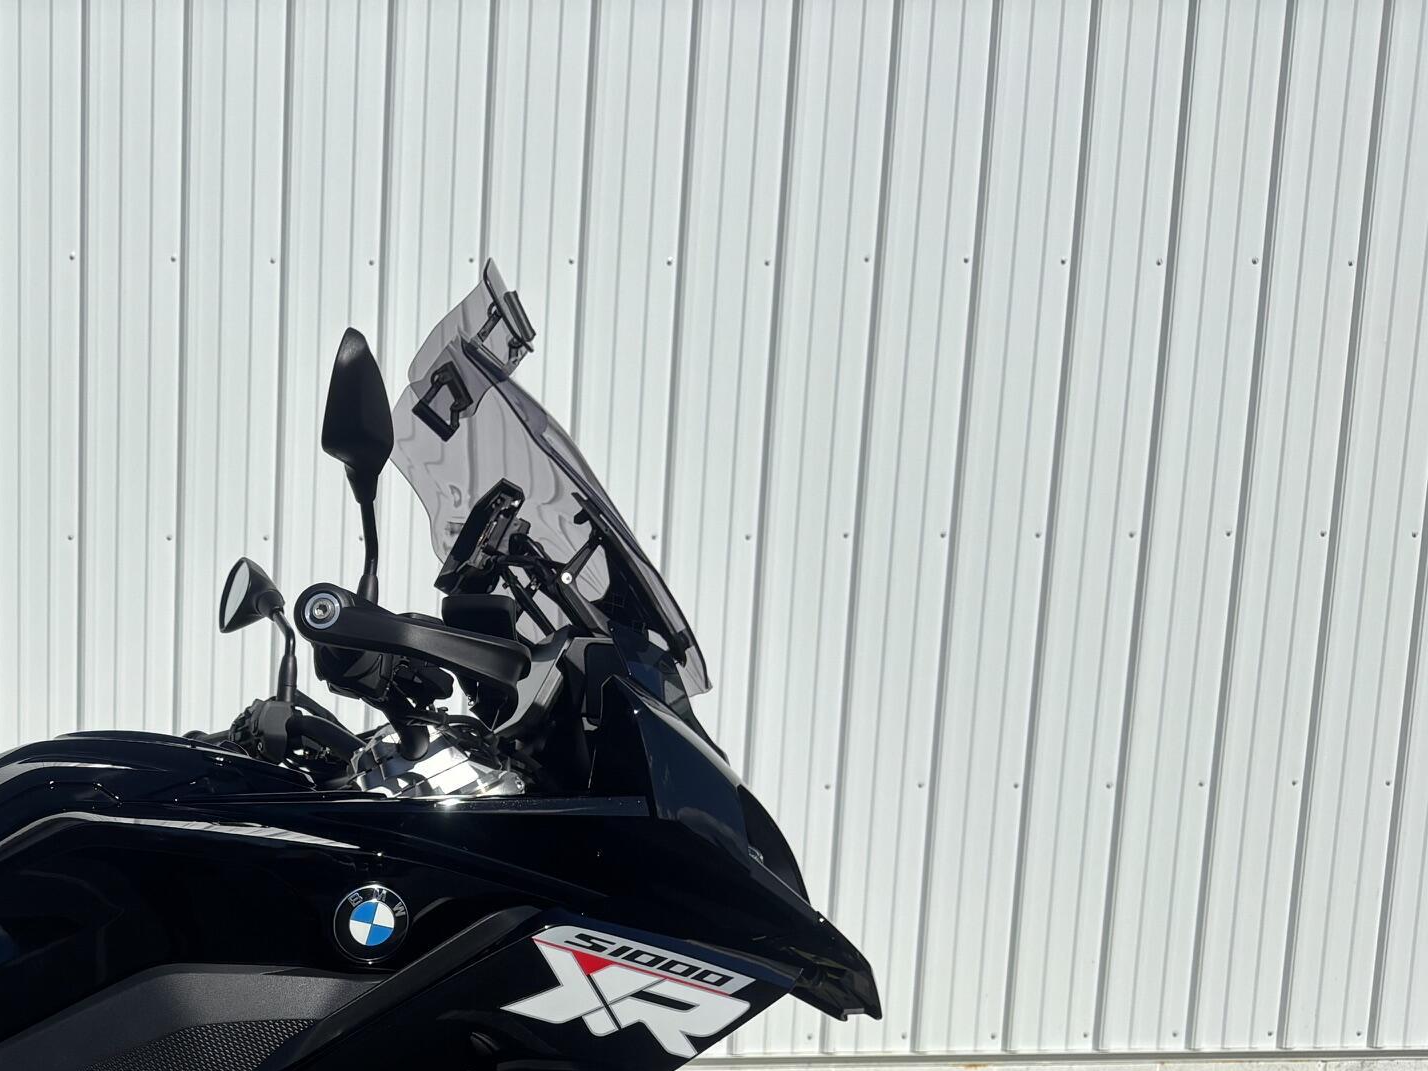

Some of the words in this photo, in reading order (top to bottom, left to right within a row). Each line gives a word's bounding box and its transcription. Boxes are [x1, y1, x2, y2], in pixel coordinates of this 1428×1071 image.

[348, 888, 406, 917] BMW
[564, 932, 734, 987] S1000
[500, 938, 751, 1059] XR
